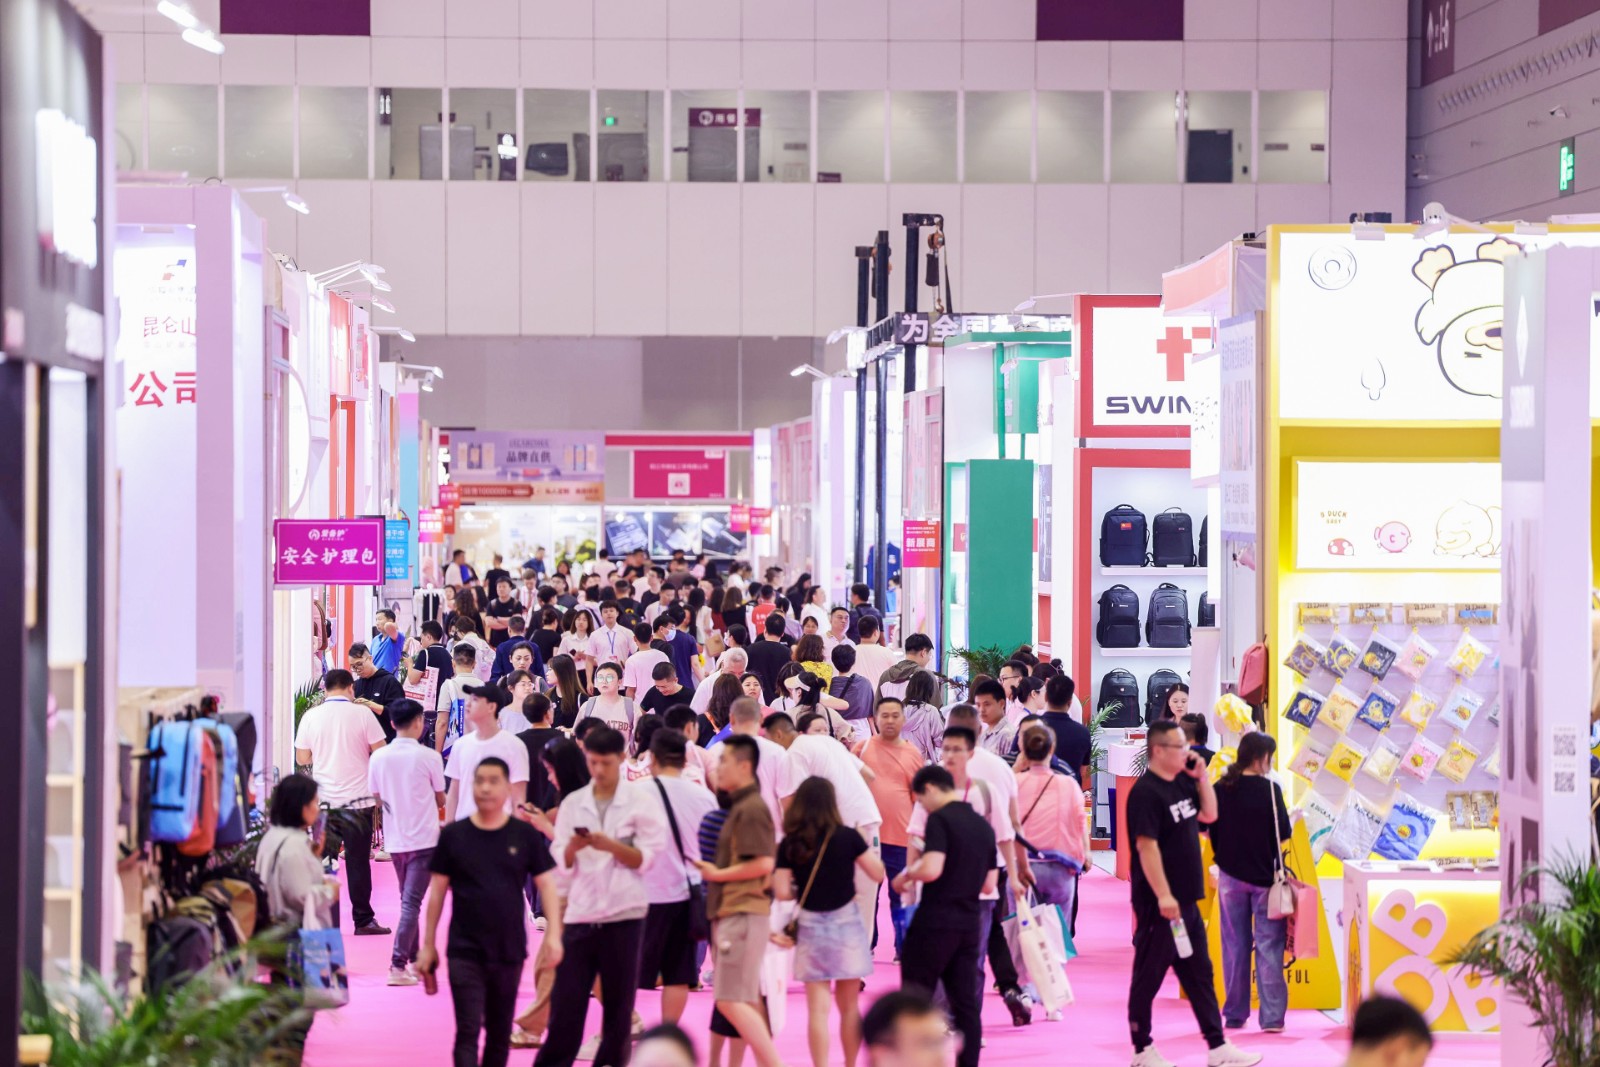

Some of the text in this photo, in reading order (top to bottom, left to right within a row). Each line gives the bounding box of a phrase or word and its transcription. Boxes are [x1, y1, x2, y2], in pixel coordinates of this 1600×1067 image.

[129, 371, 196, 408] 公司
[281, 546, 377, 566] 安全护理包
